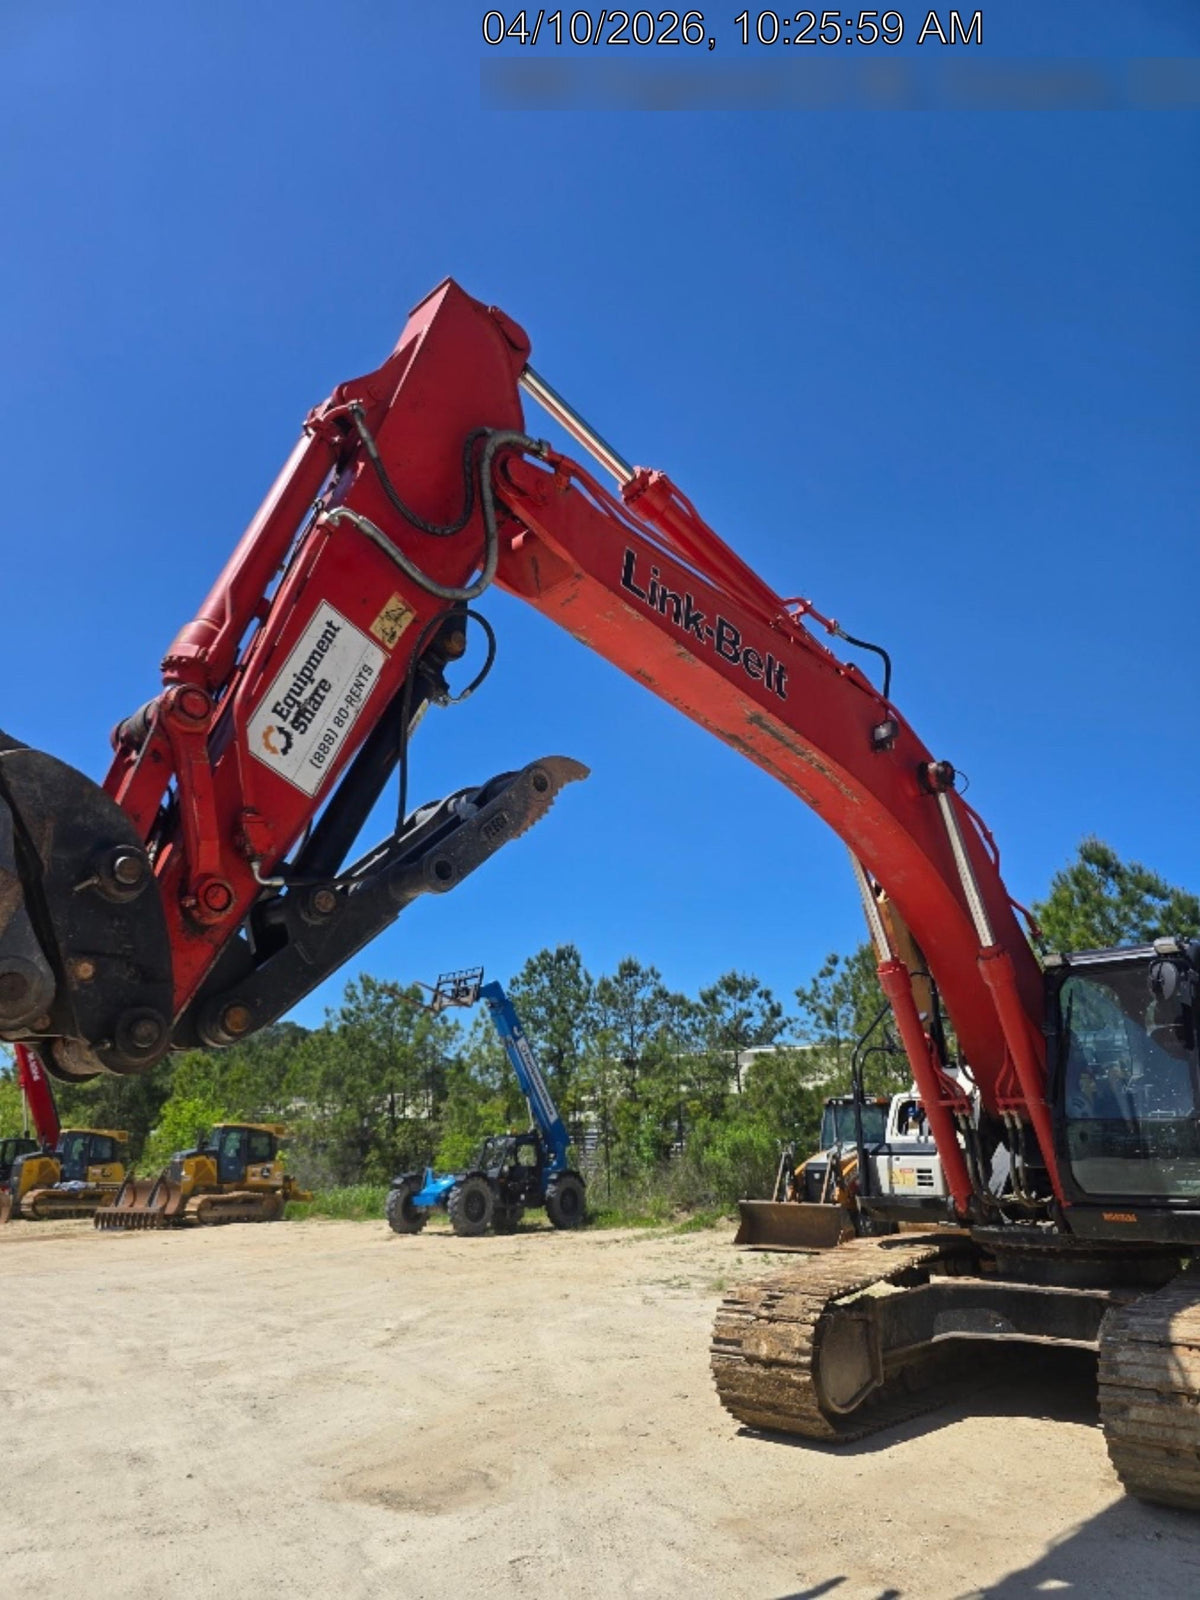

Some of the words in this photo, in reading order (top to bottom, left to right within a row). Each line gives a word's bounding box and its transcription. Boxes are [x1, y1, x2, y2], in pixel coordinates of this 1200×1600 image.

[271, 619, 341, 723] Equipment
[620, 546, 788, 701] Link-Belt
[290, 678, 332, 735] Share
[309, 727, 339, 769] (888)
[334, 663, 374, 727] 80-RENTS
